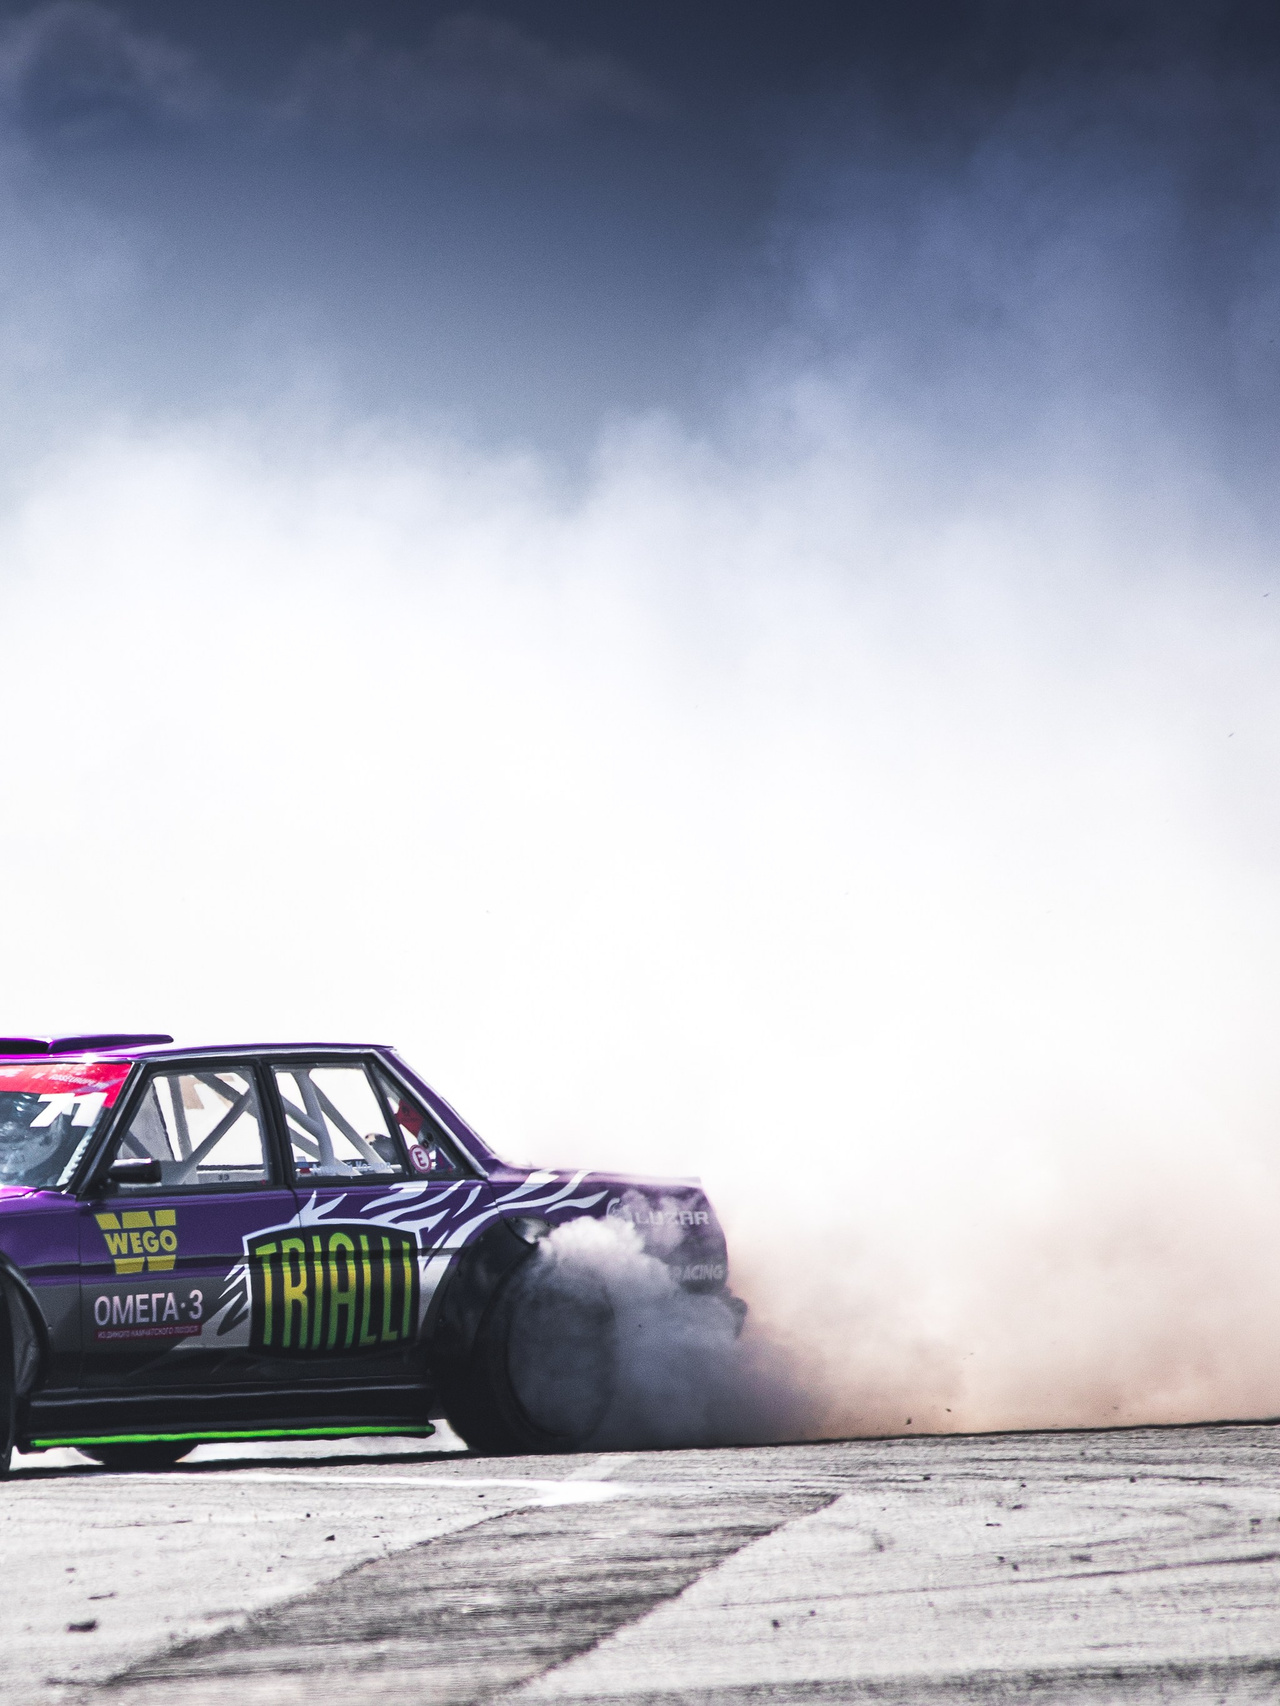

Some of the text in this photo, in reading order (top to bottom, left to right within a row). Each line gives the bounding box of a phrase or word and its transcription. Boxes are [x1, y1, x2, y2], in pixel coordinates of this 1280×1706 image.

[29, 1092, 109, 1128] 71
[415, 1151, 427, 1167] E
[104, 1229, 178, 1256] WEGO
[255, 1232, 413, 1350] TRIALLI
